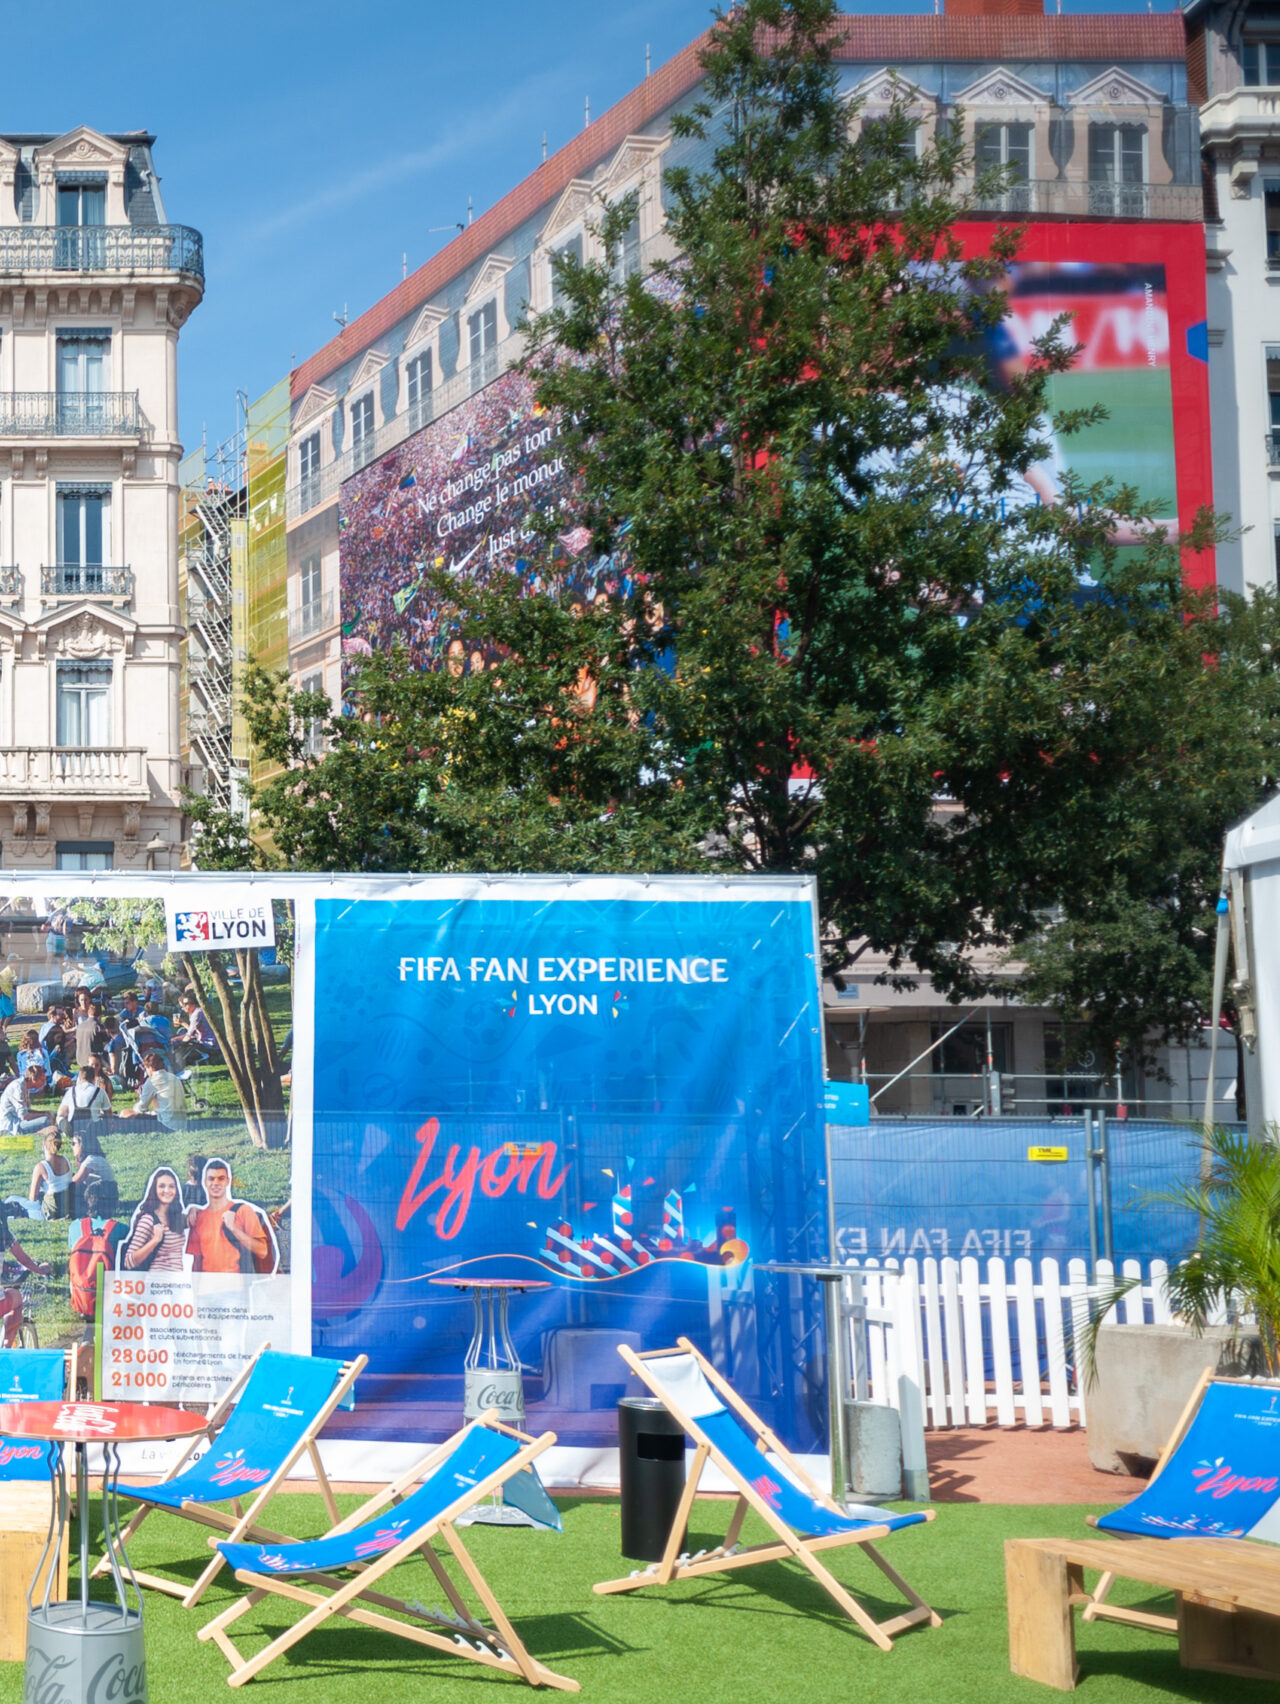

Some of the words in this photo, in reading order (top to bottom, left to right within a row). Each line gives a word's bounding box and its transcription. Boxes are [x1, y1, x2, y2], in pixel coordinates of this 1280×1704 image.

[417, 493, 437, 520] Ne
[440, 463, 491, 504] change
[494, 444, 521, 480] pas
[525, 426, 552, 454] ton
[437, 496, 492, 538] Change
[495, 483, 509, 507] le
[488, 526, 516, 562] Just
[210, 907, 244, 920] VILLE
[248, 906, 265, 919] DE
[211, 919, 266, 940] LYON
[396, 957, 461, 982] FIFA
[467, 957, 531, 984] FAN
[537, 957, 729, 985] EXPERIENCE
[528, 994, 598, 1015] LYON
[395, 1116, 574, 1241] Lyon
[112, 1280, 146, 1295] 350
[112, 1325, 145, 1340] 200
[111, 1348, 133, 1363] 28
[136, 1349, 169, 1364] 000
[111, 1371, 131, 1387] 21
[134, 1372, 167, 1388] 000
[209, 1458, 271, 1486] Lyon
[1195, 1466, 1279, 1499] Lyon
